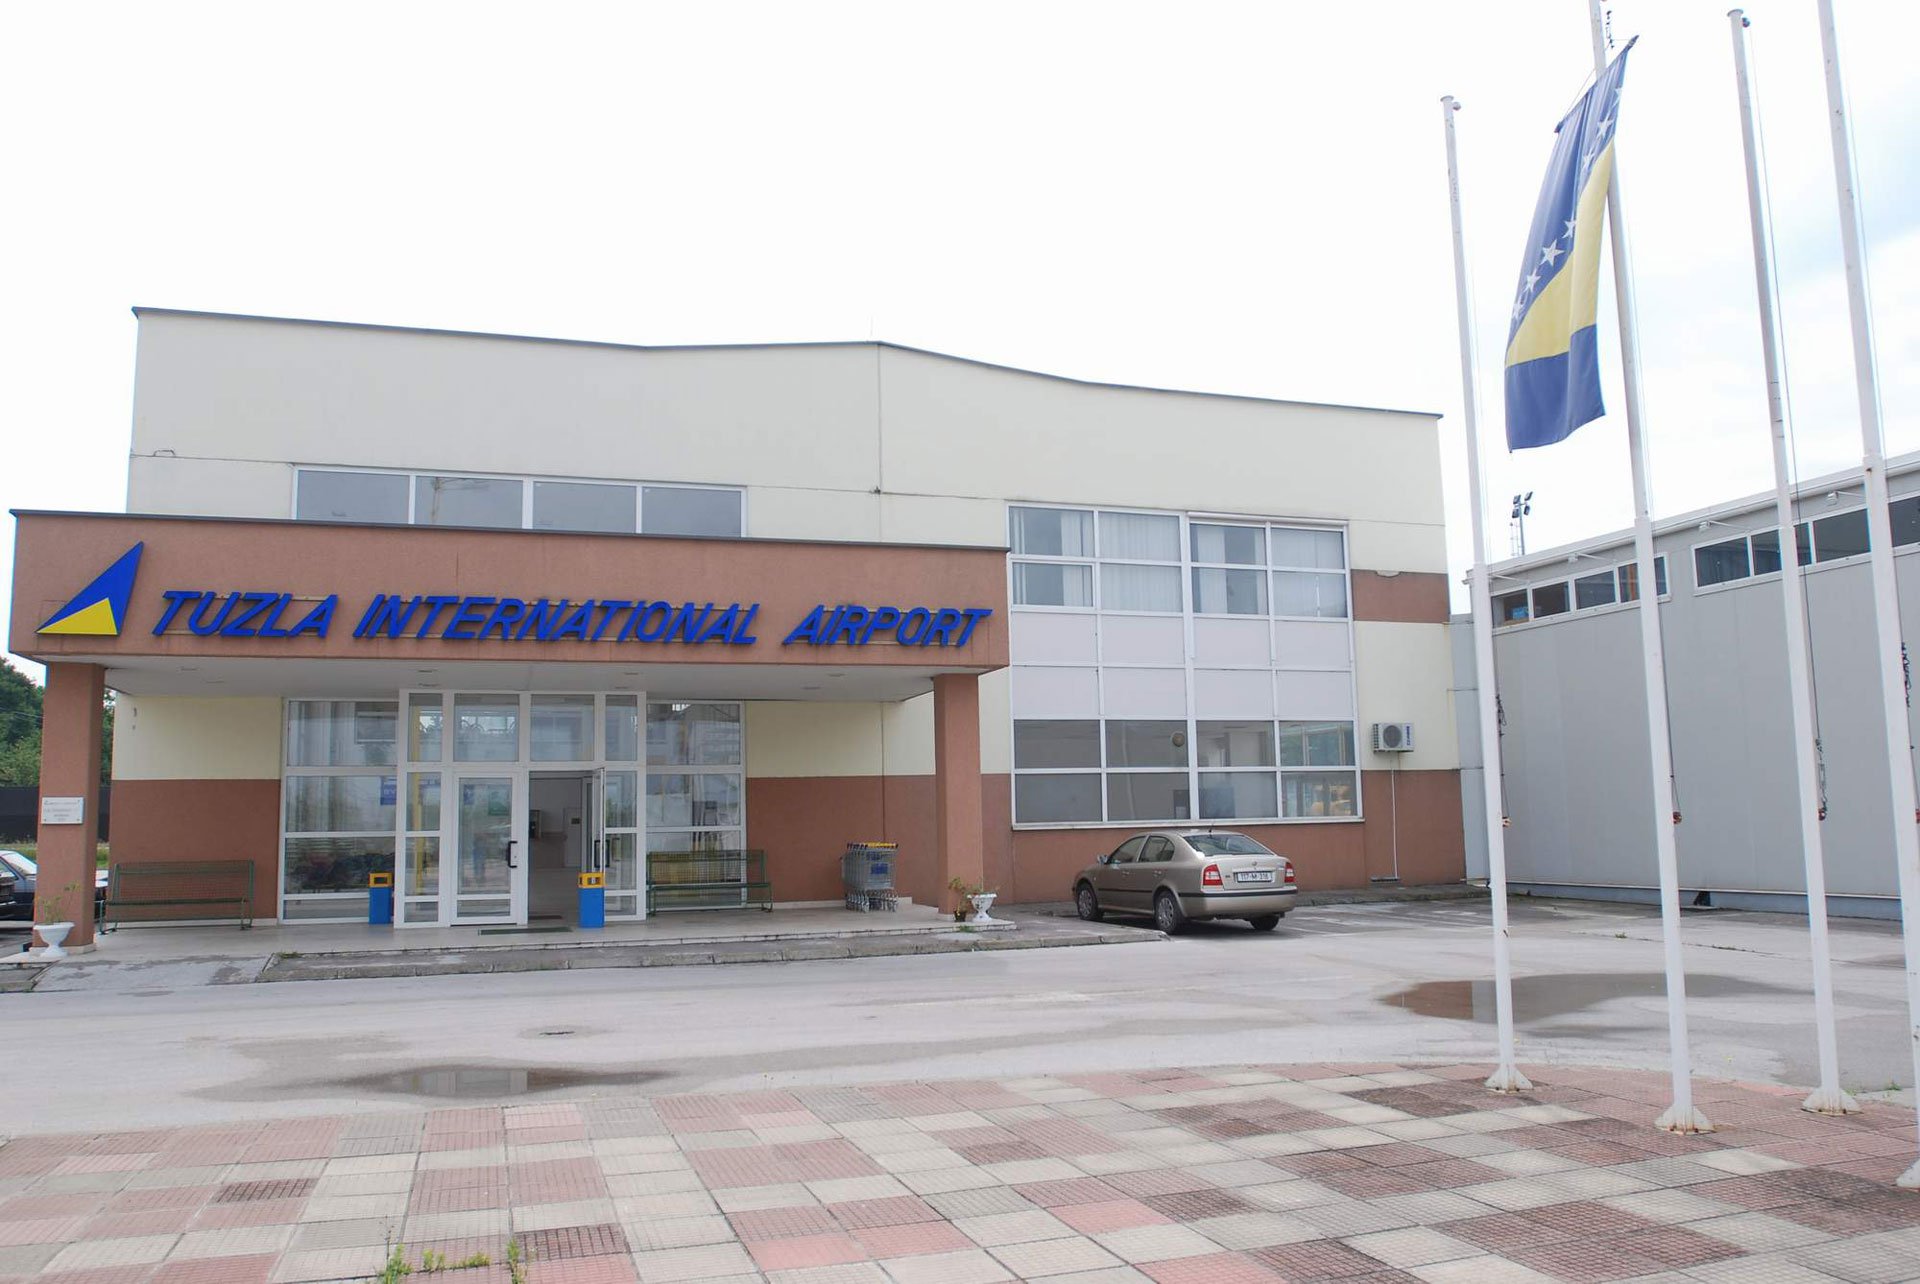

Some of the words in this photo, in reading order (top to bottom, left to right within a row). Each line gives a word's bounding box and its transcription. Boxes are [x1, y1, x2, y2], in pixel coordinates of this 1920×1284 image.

[153, 591, 337, 638] TUZLA
[354, 595, 760, 645] INTERNATIONAL
[784, 605, 993, 647] AIRPORT
